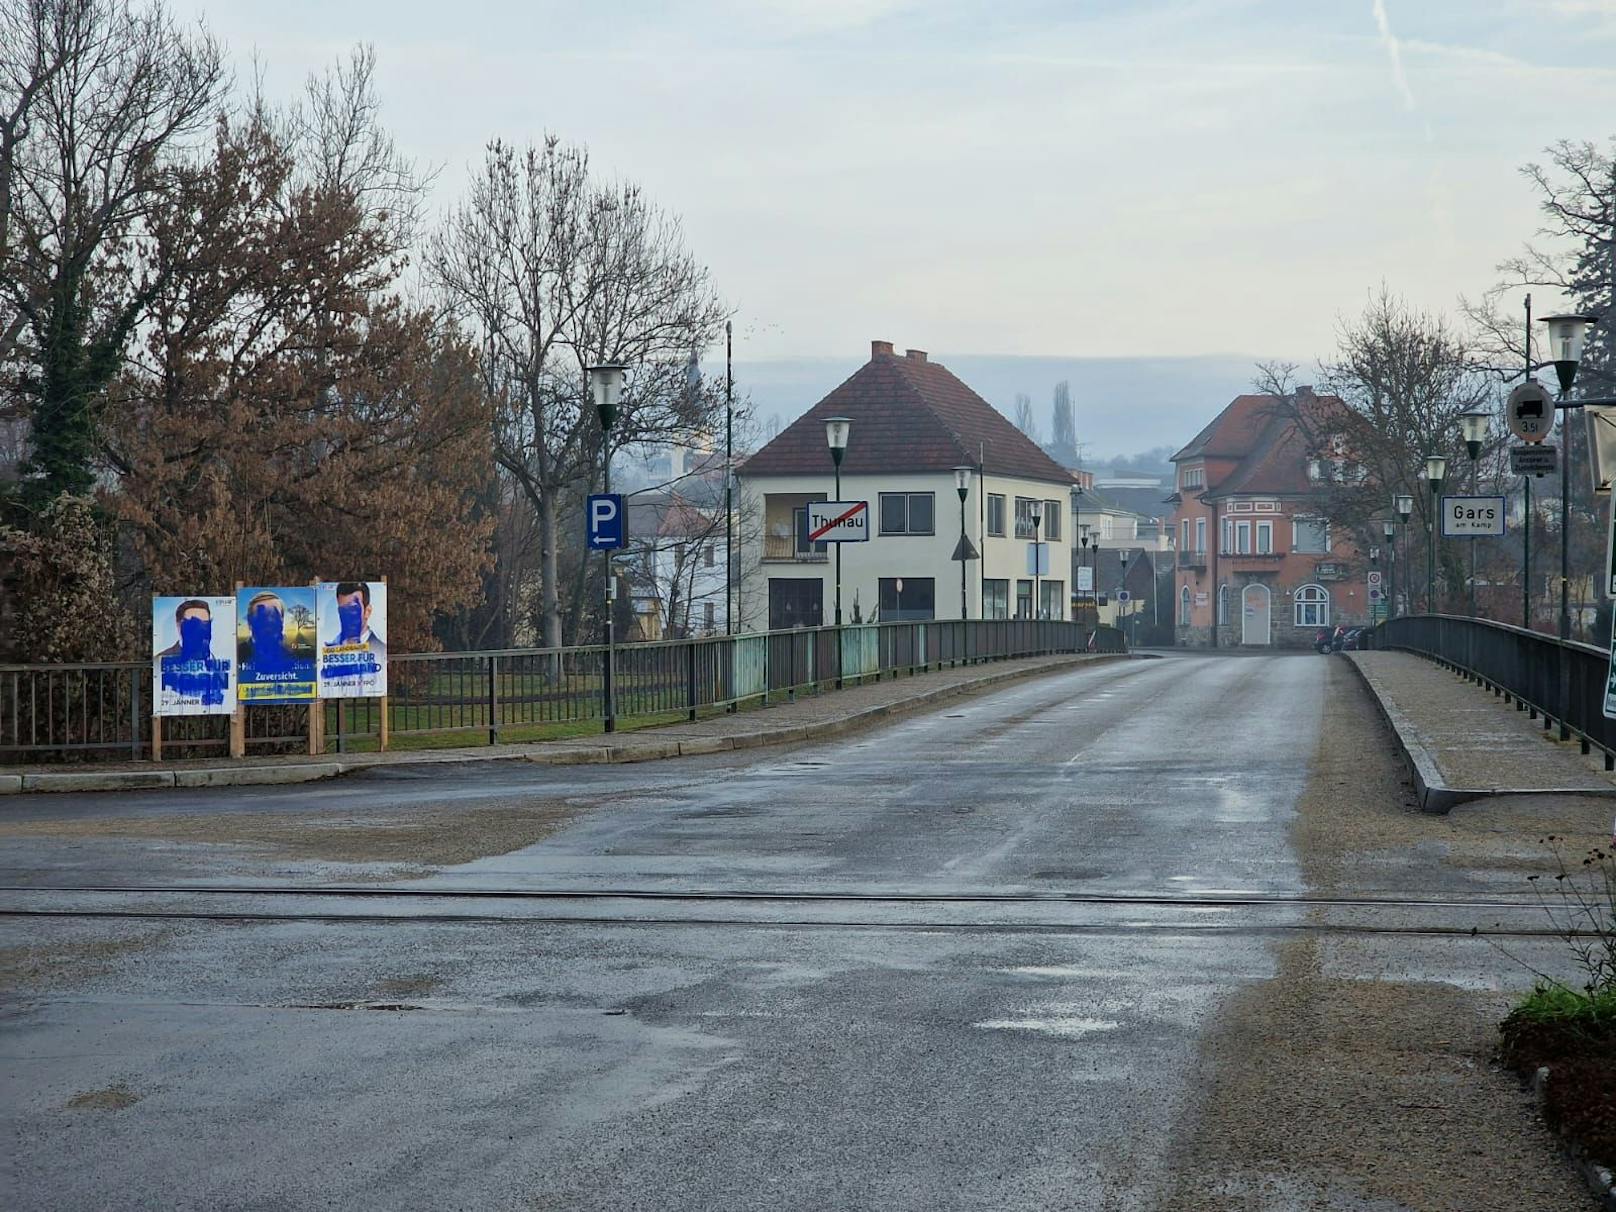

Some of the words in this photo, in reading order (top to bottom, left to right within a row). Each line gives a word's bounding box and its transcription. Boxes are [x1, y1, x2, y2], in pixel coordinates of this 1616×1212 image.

[592, 500, 617, 532] P
[1454, 505, 1494, 519] Gars
[812, 515, 863, 528] Thunau
[323, 653, 357, 663] BESSER
[255, 671, 299, 681] Zuversicht.
